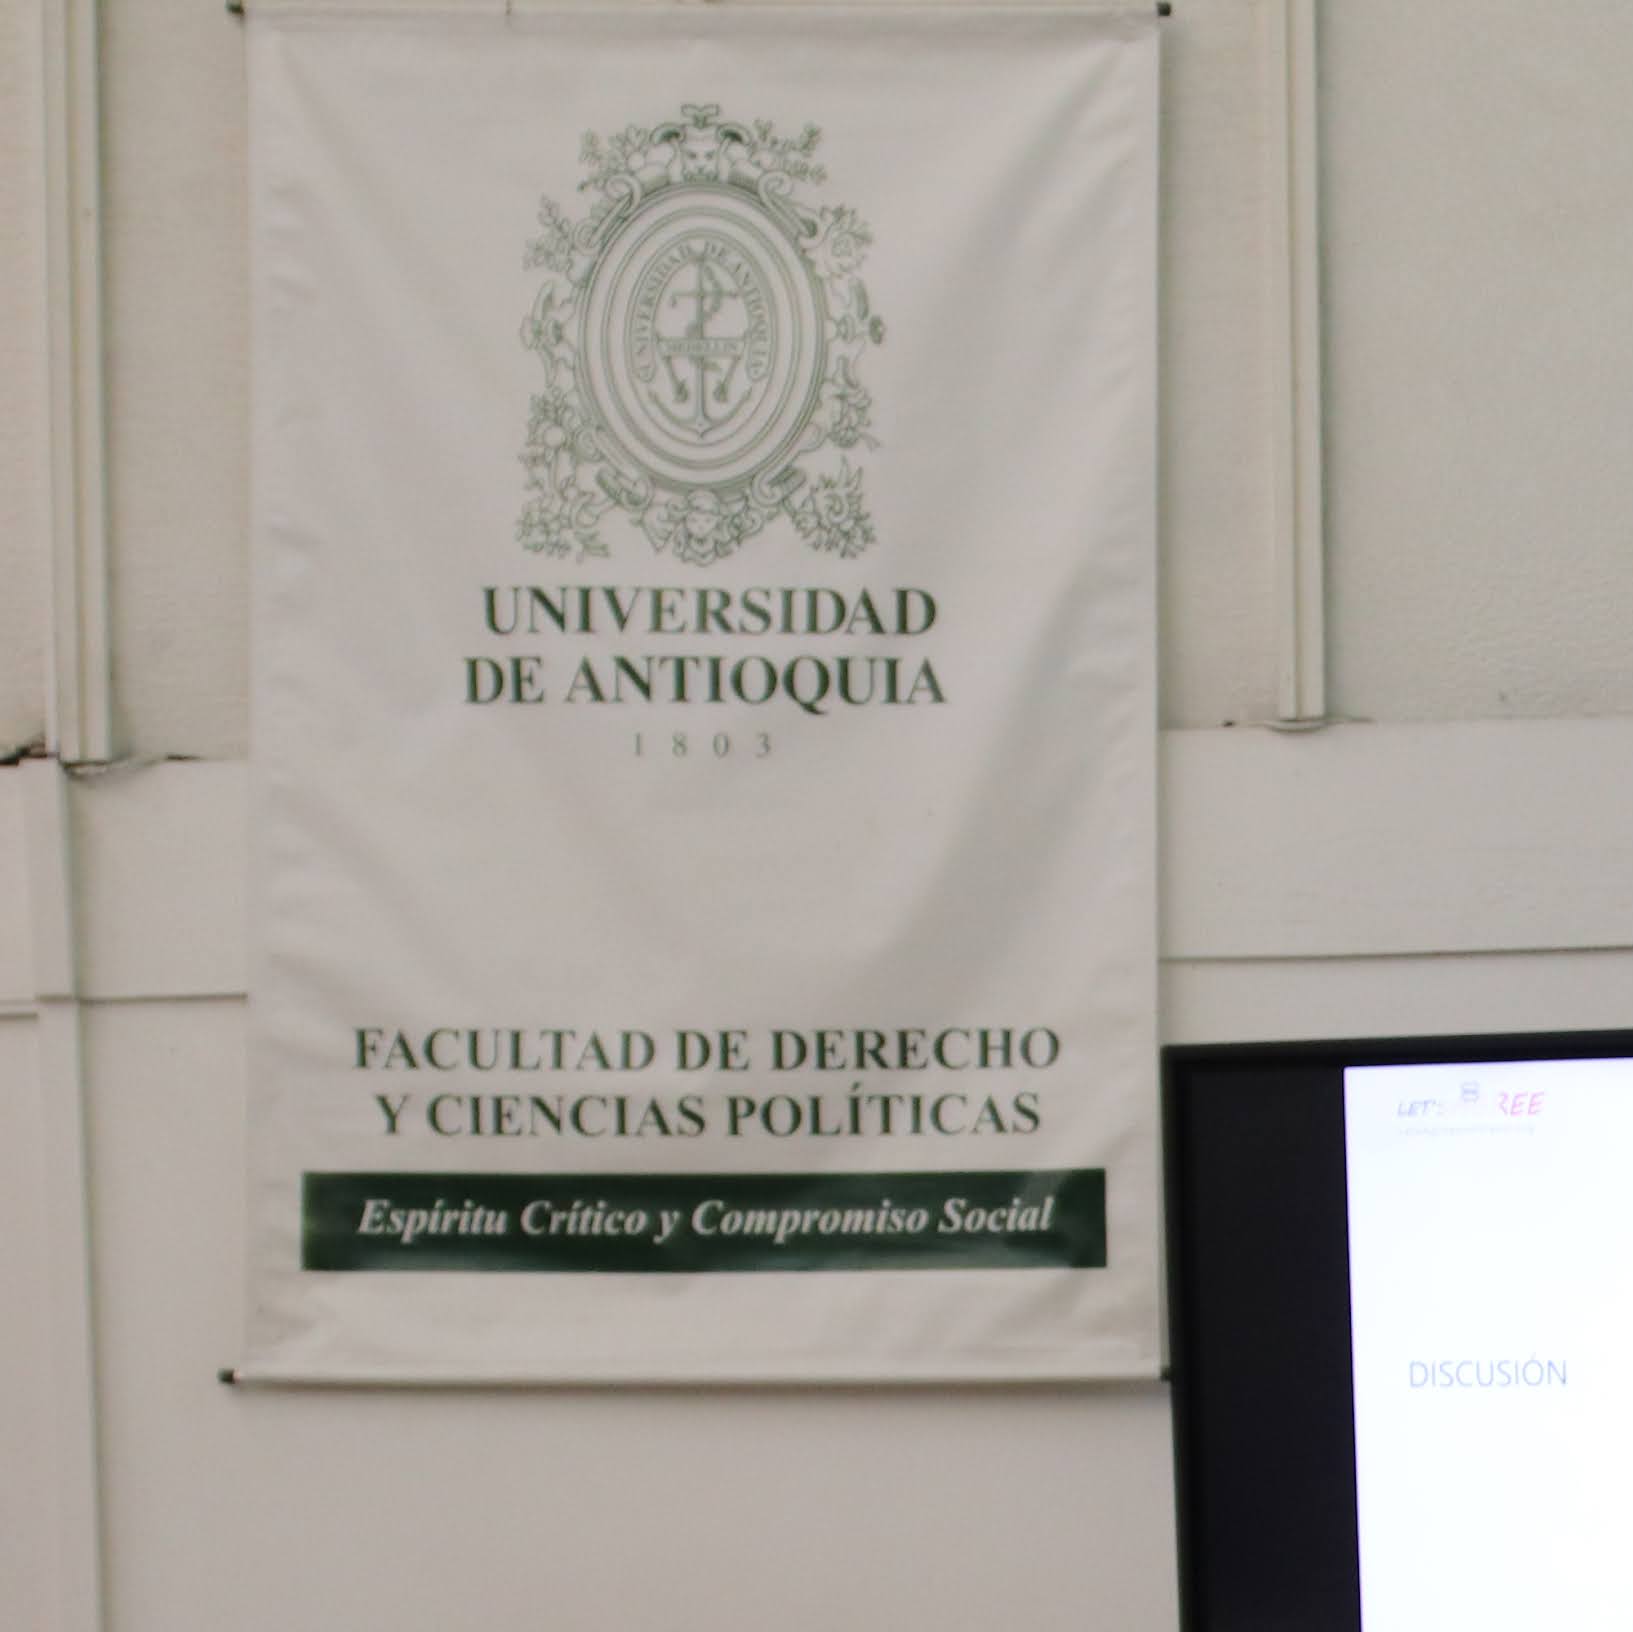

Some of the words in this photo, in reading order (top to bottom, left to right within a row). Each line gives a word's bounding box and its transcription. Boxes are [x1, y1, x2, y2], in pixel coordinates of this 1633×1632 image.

[482, 585, 938, 637] UNIVERSIDAD
[464, 654, 546, 706] DE
[564, 654, 947, 716] ANTIOQUIA
[632, 730, 774, 760] 1803
[353, 1026, 656, 1072] FACULTAD
[675, 1028, 751, 1072] DE
[770, 1026, 1062, 1072] DERECHO
[374, 1094, 408, 1137] Y
[425, 1093, 707, 1138] CIENCIAS
[726, 1082, 1042, 1138] POLÍTICAS
[357, 1196, 509, 1241] Espíritu
[520, 1200, 646, 1237] Crítico
[655, 1209, 680, 1244] y
[691, 1197, 928, 1244] Compromiso
[937, 1196, 1056, 1234] Social
[1408, 1351, 1569, 1389] DISCUSIÓN
